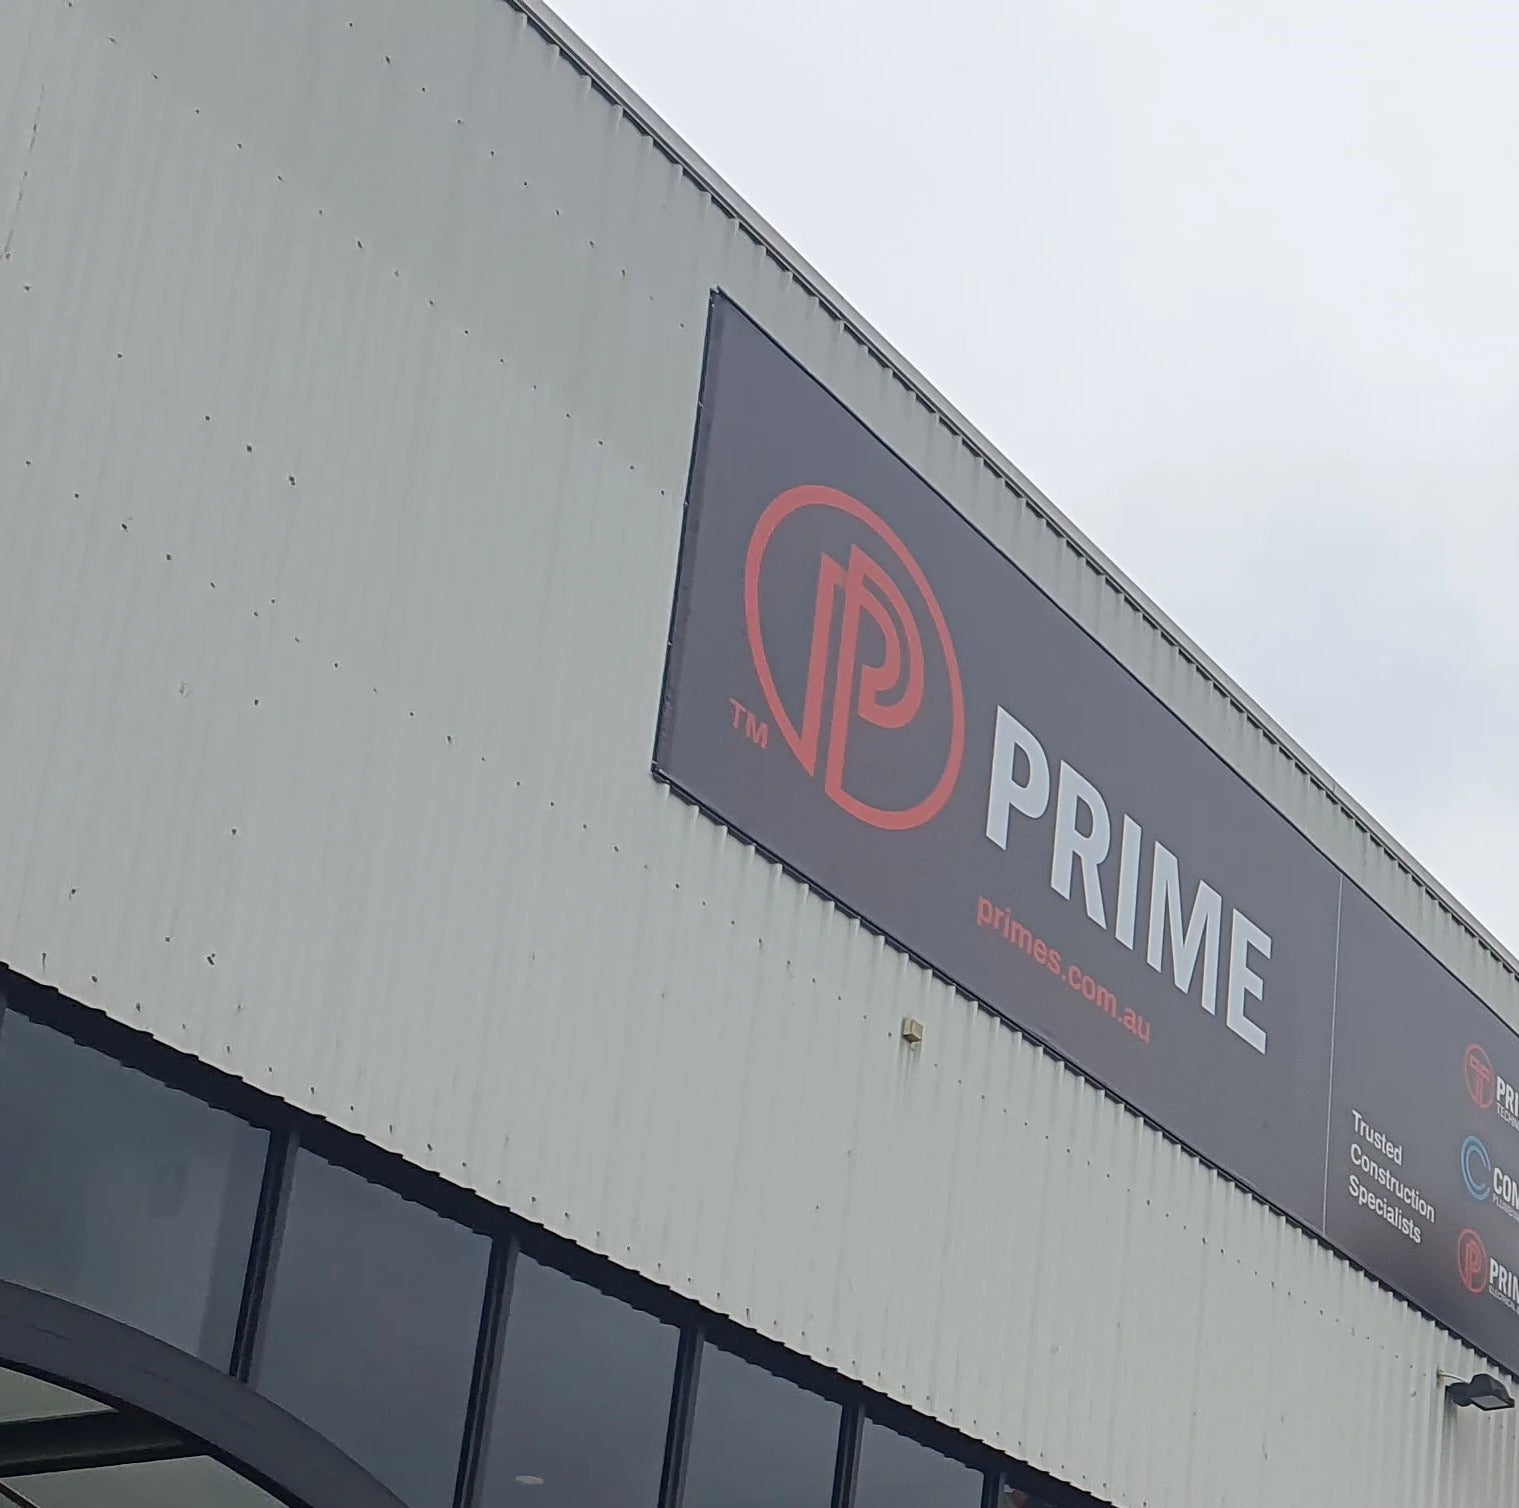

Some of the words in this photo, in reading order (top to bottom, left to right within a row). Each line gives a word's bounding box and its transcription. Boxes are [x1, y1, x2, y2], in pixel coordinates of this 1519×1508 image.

[728, 697, 769, 750] TM
[985, 704, 1272, 1055] PRIME
[976, 895, 1152, 1043] primes.com.au
[1351, 1109, 1403, 1166] Trusted
[1348, 1174, 1421, 1243] Specialists
[1350, 1143, 1435, 1223] Construction
